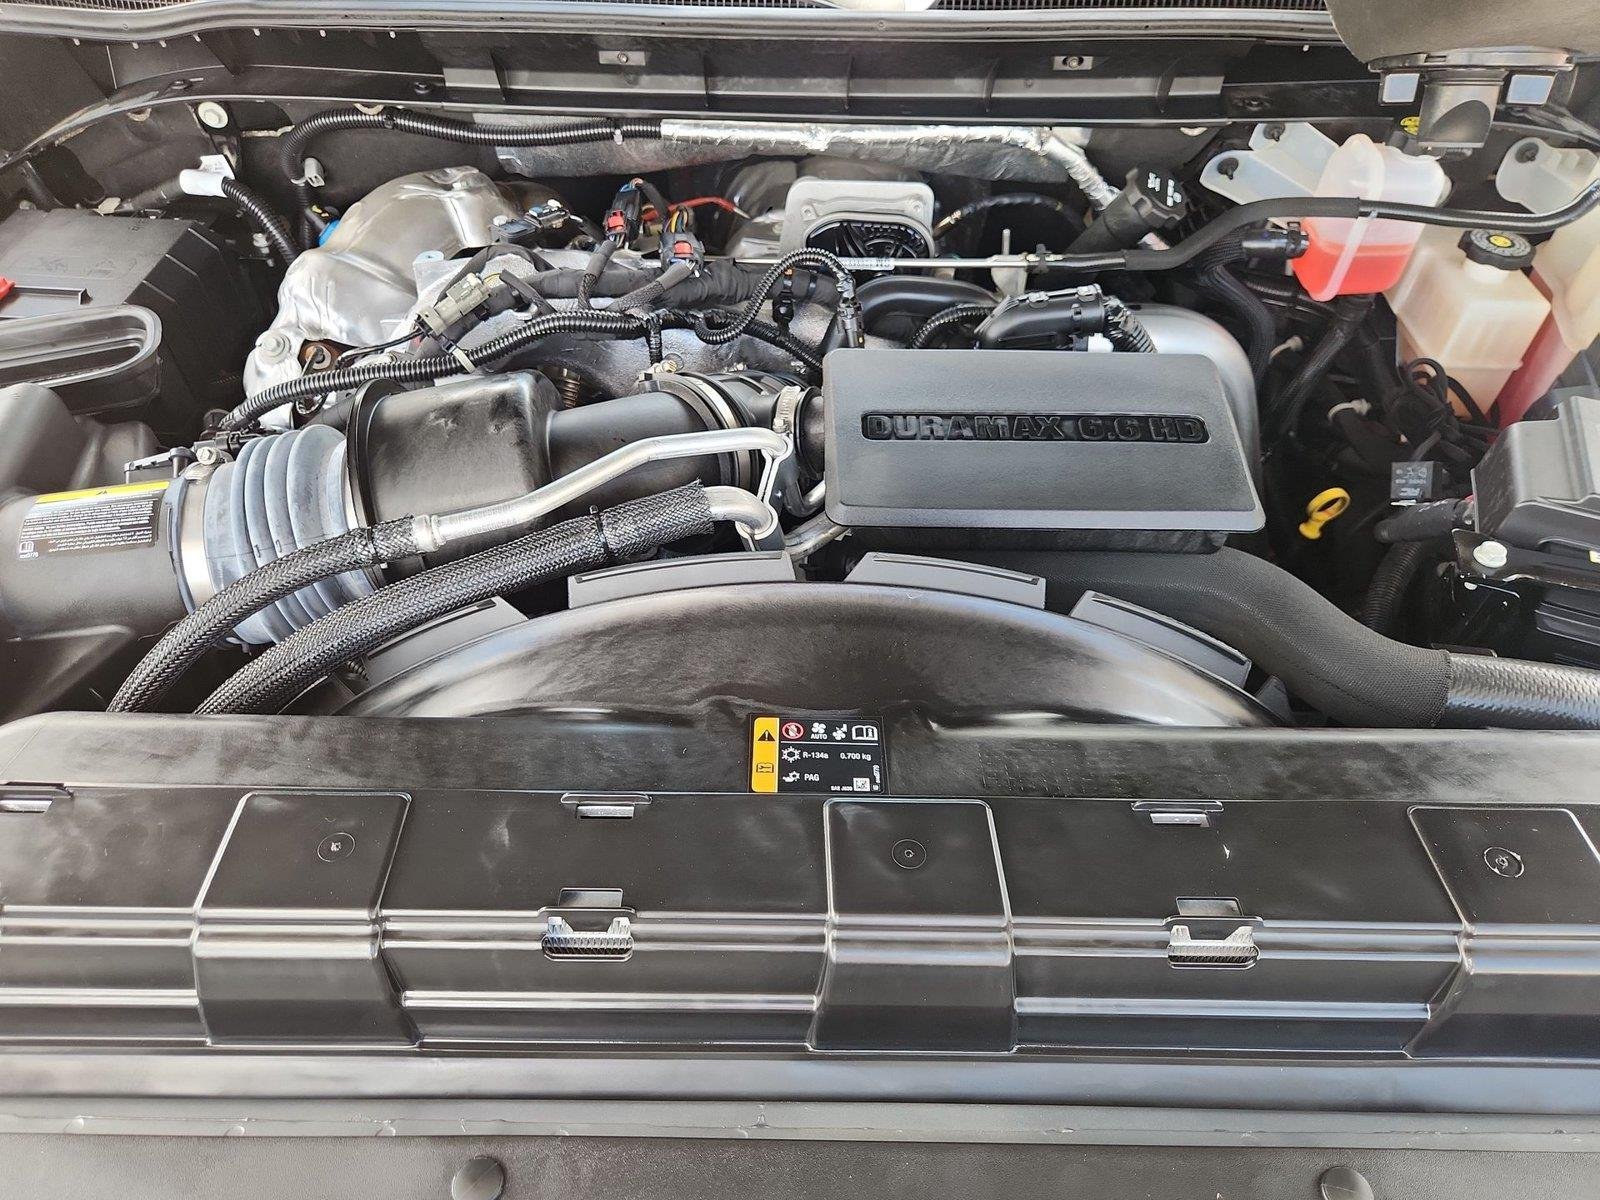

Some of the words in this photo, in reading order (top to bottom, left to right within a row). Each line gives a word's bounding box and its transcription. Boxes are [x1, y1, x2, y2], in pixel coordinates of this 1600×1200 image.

[866, 415, 1064, 440] DURAMAX
[1077, 416, 1141, 441] 6.6
[1152, 417, 1207, 442] HD
[840, 752, 860, 760] 0.700
[862, 753, 872, 762] kg
[804, 774, 820, 782] PAG
